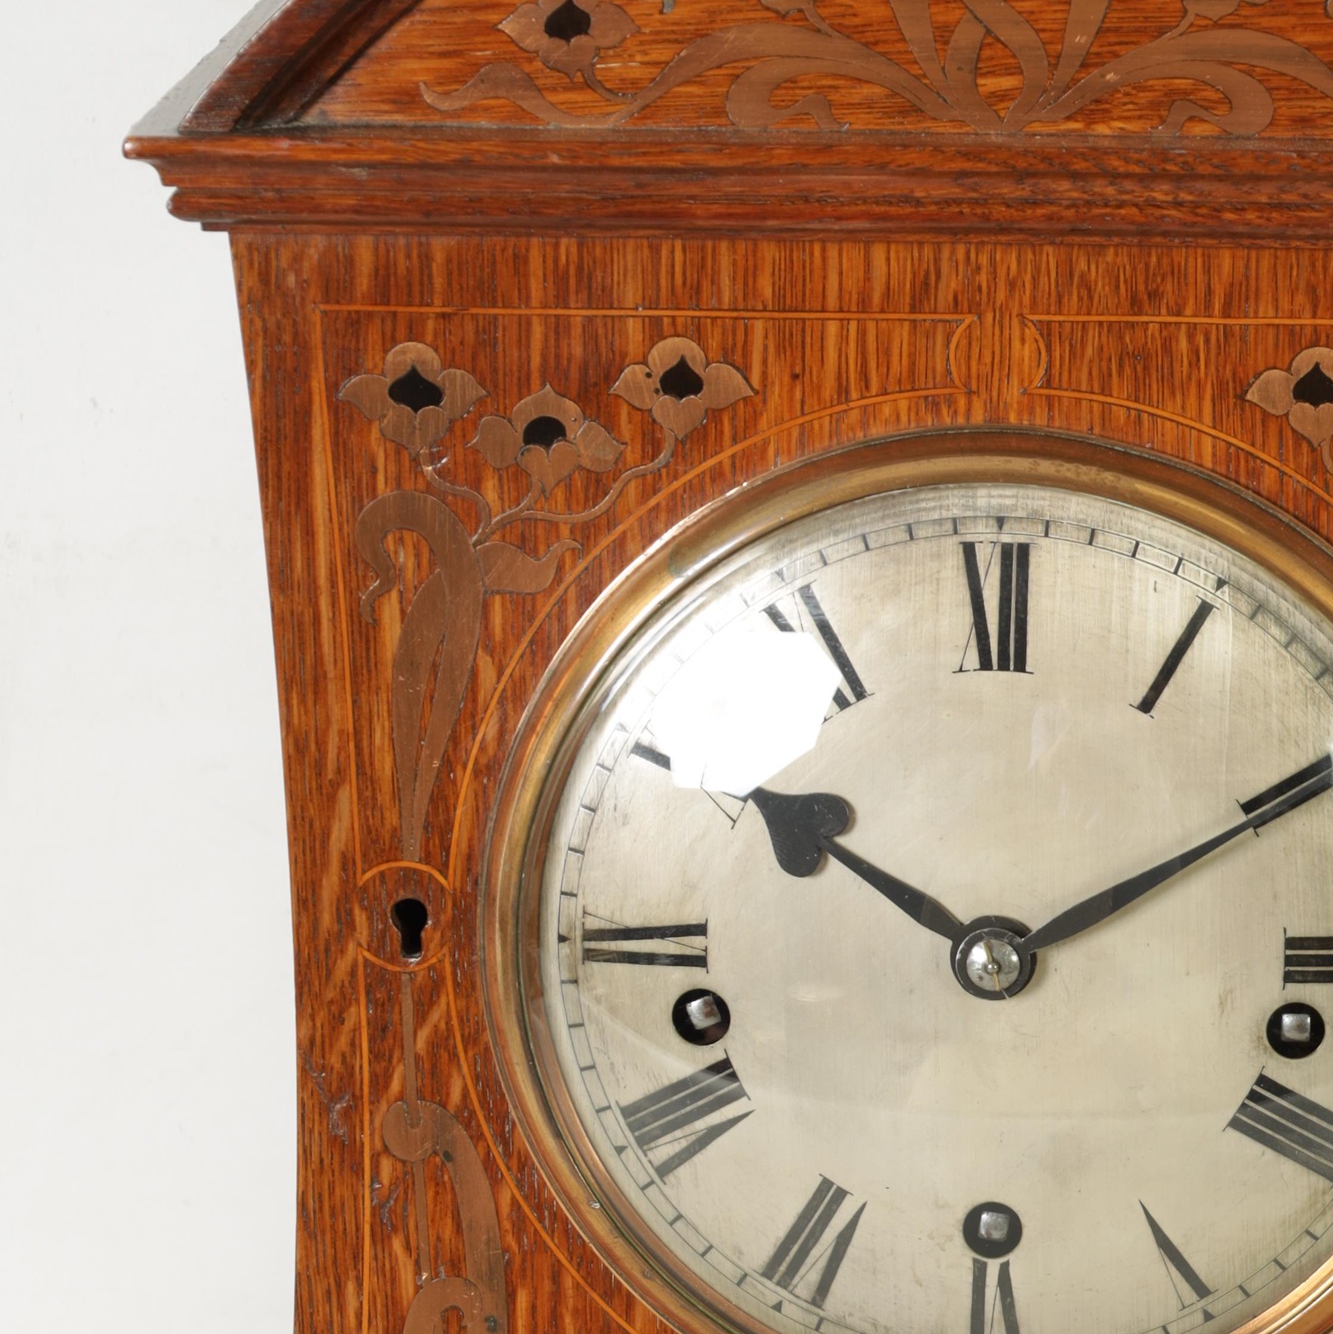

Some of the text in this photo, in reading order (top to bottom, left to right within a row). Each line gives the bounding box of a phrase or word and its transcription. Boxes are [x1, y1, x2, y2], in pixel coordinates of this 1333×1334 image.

[952, 541, 1037, 674] XII
[1129, 596, 1219, 718] I
[582, 905, 709, 974] IX
[616, 1048, 755, 1185] VIII
[761, 1173, 868, 1310] VII
[1138, 1199, 1218, 1311] V
